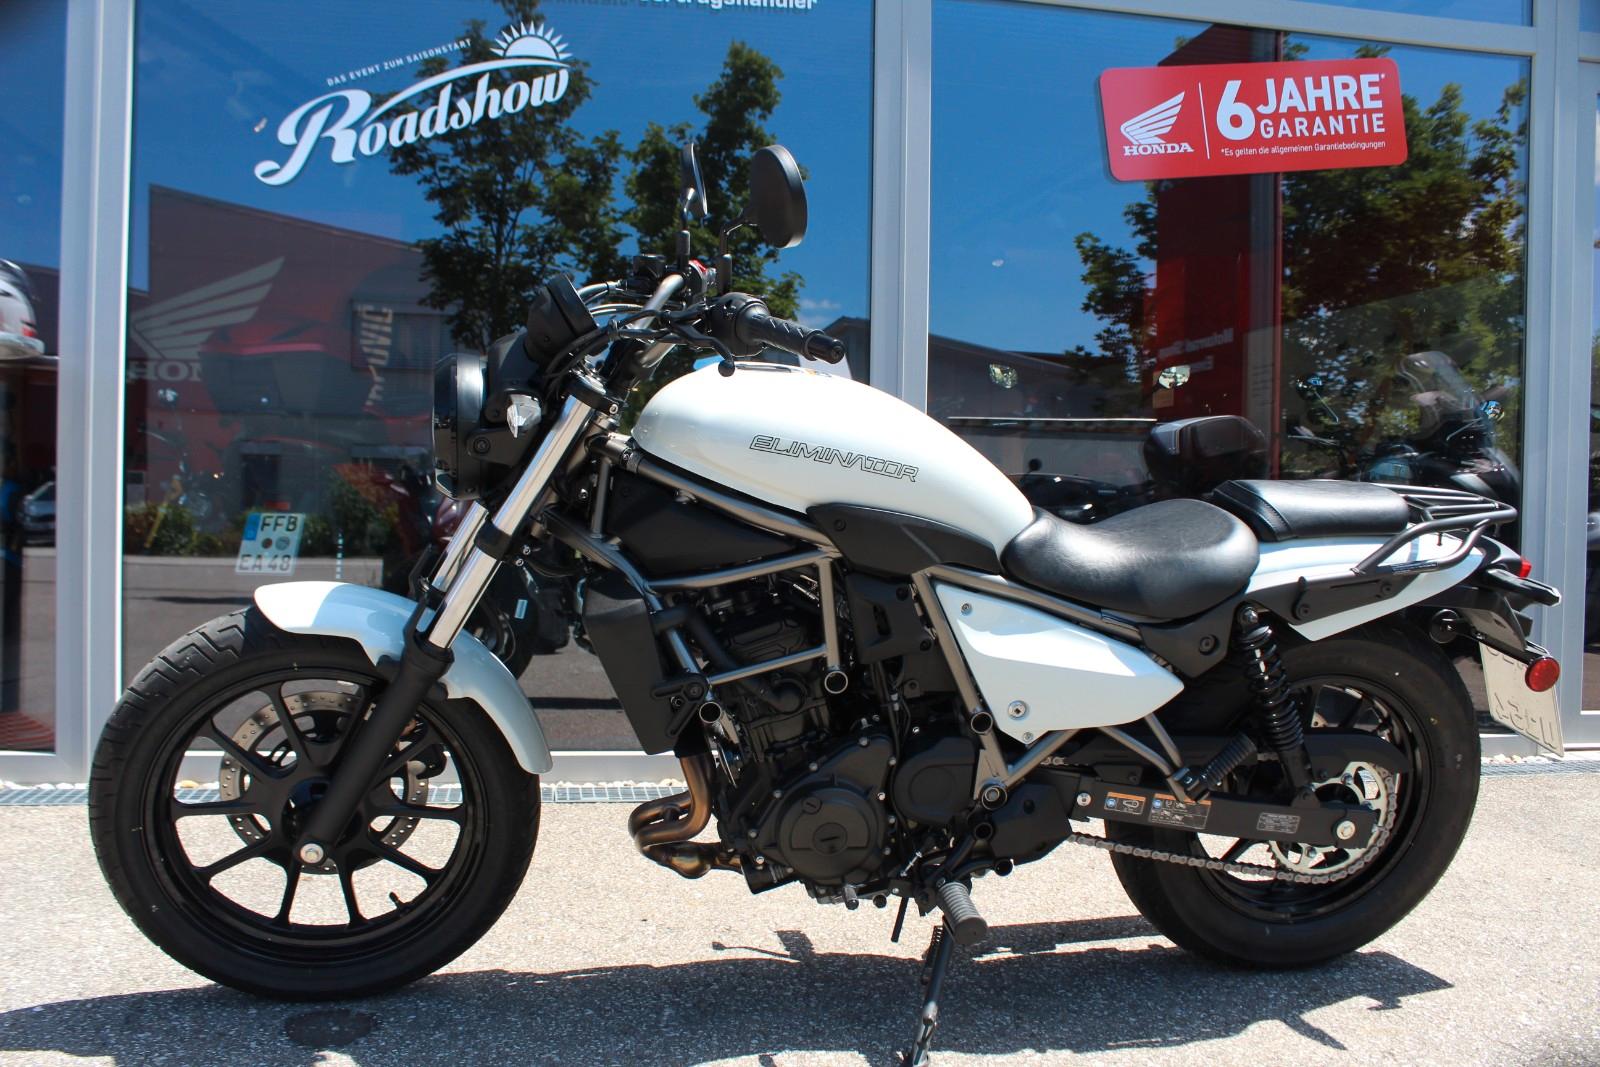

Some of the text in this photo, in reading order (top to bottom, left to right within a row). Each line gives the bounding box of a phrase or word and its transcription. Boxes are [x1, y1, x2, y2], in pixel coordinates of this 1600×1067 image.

[327, 38, 472, 86] DAS EVENT ZUM SAISONSTART
[1216, 80, 1255, 141] 6
[254, 68, 570, 186] Roadshow
[1260, 113, 1386, 139] GARANTIE
[1123, 142, 1194, 156] HONDA
[1235, 147, 1257, 157] gelten
[1259, 145, 1269, 154] die
[1271, 144, 1313, 154] allgemeinen
[1315, 140, 1386, 151] Garantiebedingungen
[749, 434, 919, 482] ELIMINATOR
[261, 515, 298, 532] FFB
[239, 554, 291, 571] EA 48
